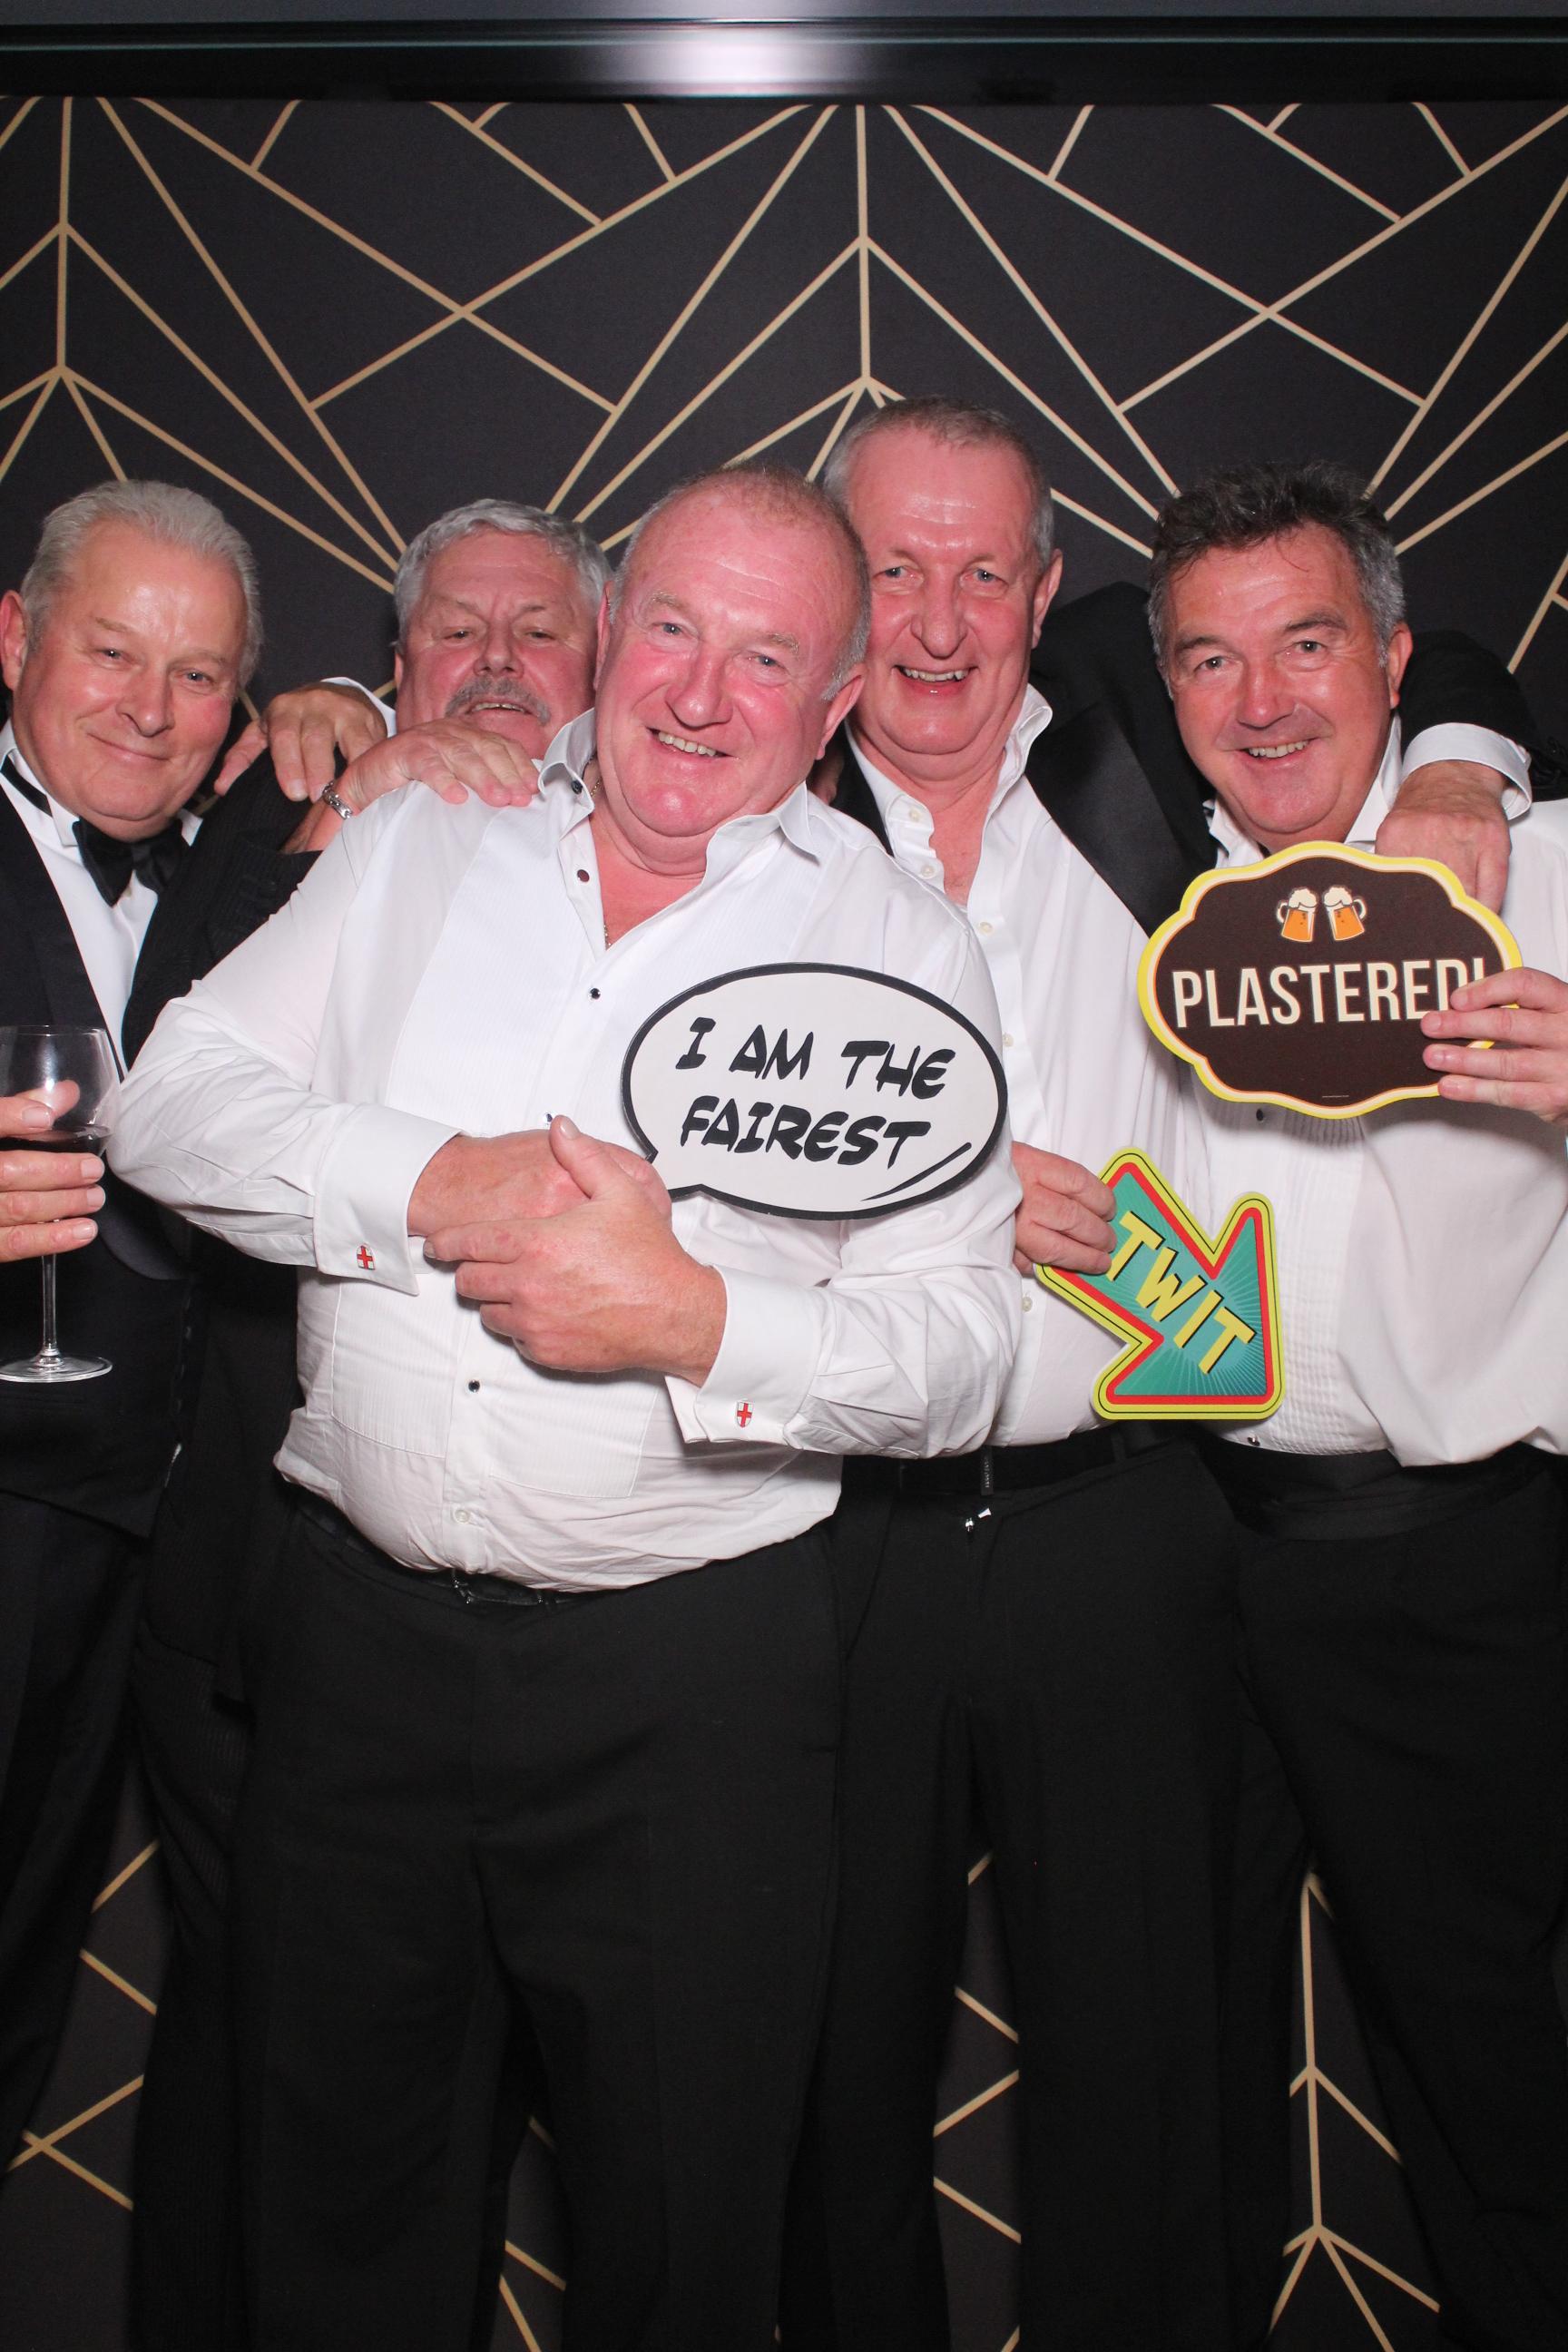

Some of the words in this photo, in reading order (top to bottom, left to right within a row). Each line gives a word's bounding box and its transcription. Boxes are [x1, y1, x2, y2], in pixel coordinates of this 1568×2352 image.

[675, 1016, 716, 1070] I
[729, 1024, 814, 1080] AM
[840, 1040, 956, 1100] THE
[680, 1094, 931, 1170] FAIREST
[1105, 1210, 1257, 1375] TWIT
